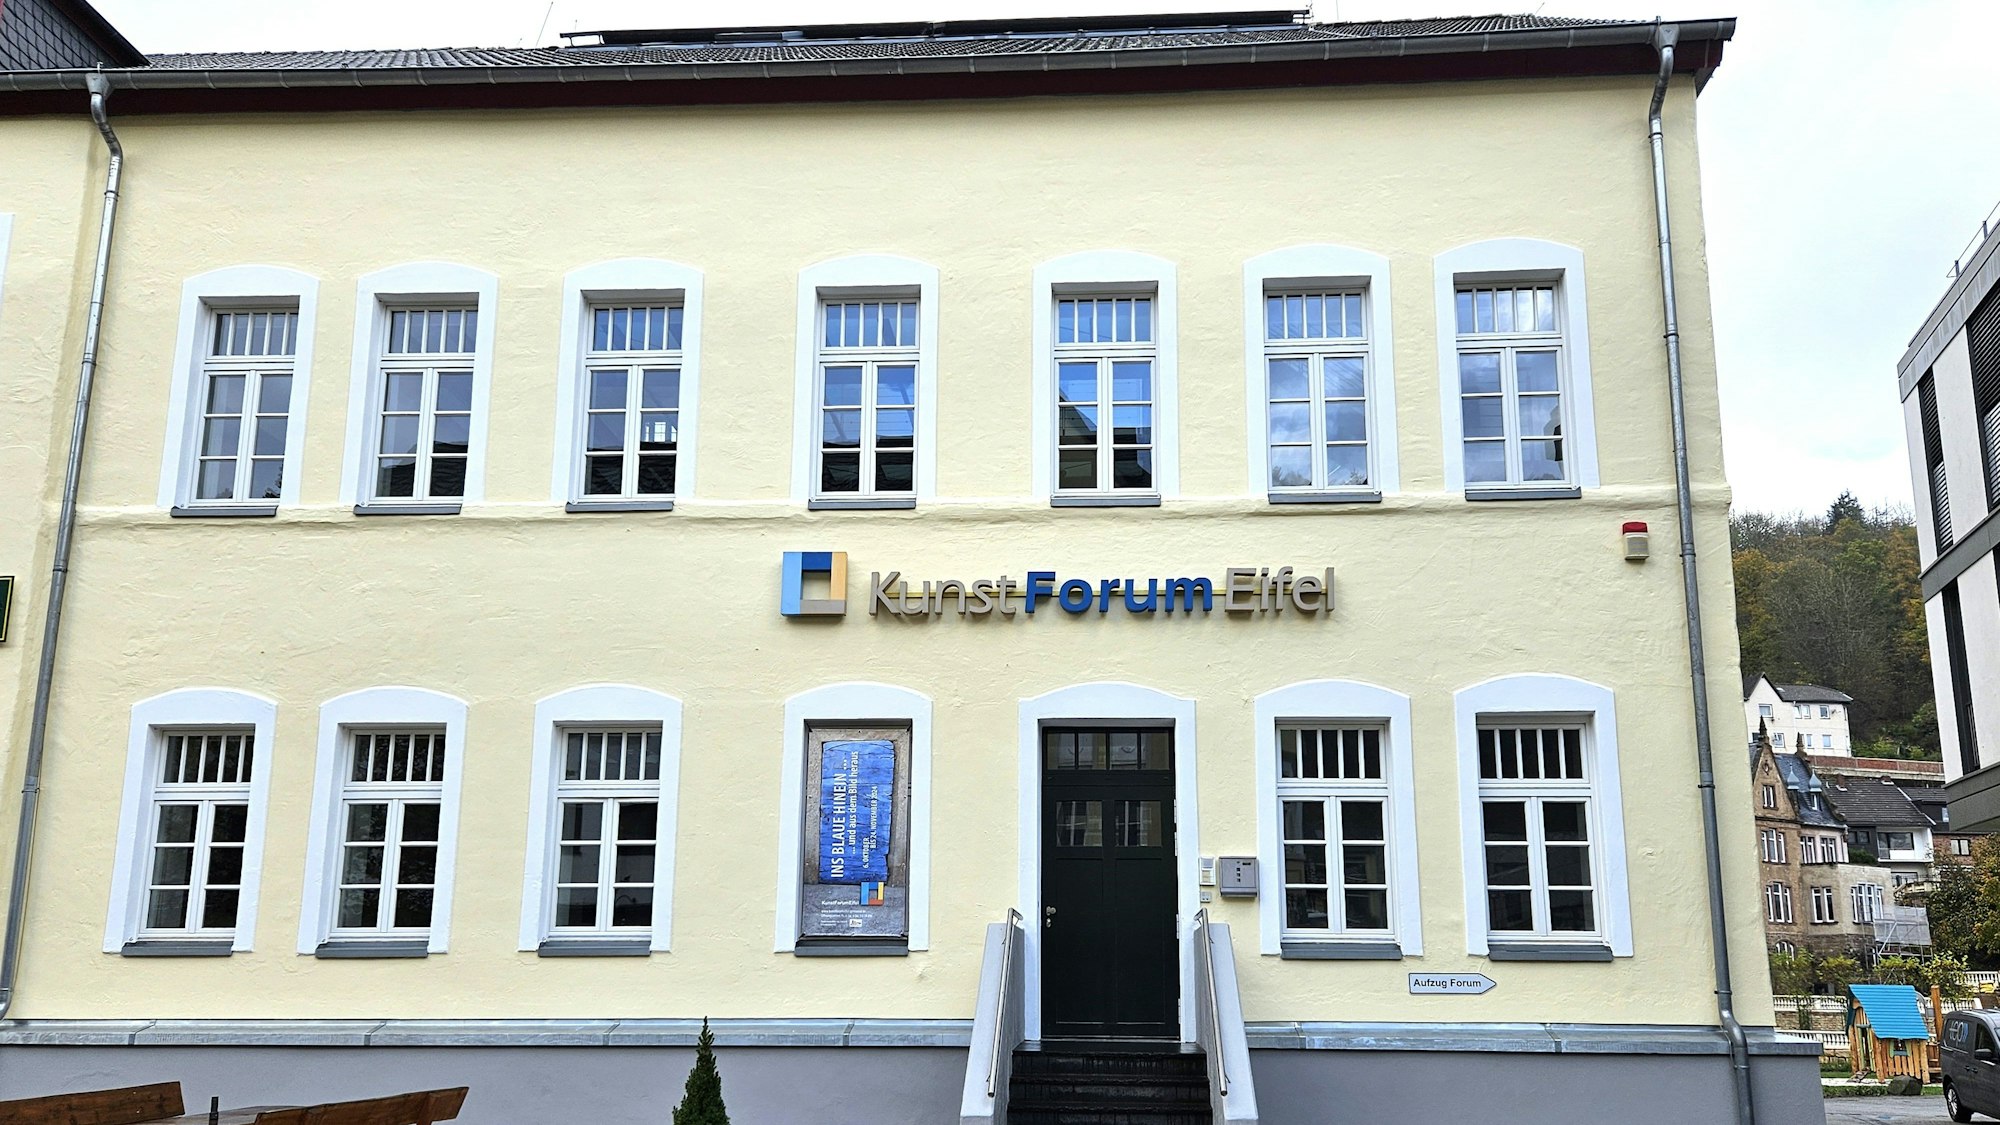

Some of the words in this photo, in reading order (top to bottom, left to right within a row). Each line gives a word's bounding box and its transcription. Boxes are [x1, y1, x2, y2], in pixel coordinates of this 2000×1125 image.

[849, 751, 858, 777] heraus
[833, 774, 847, 814] HINEIN
[848, 779, 858, 794] Bild
[848, 796, 857, 813] dem
[849, 815, 857, 828] aus
[832, 816, 845, 855] BLAUE
[847, 830, 857, 845] und
[828, 857, 843, 877] INS
[1414, 979, 1447, 988] Aufzug
[1450, 979, 1481, 987] Forum
